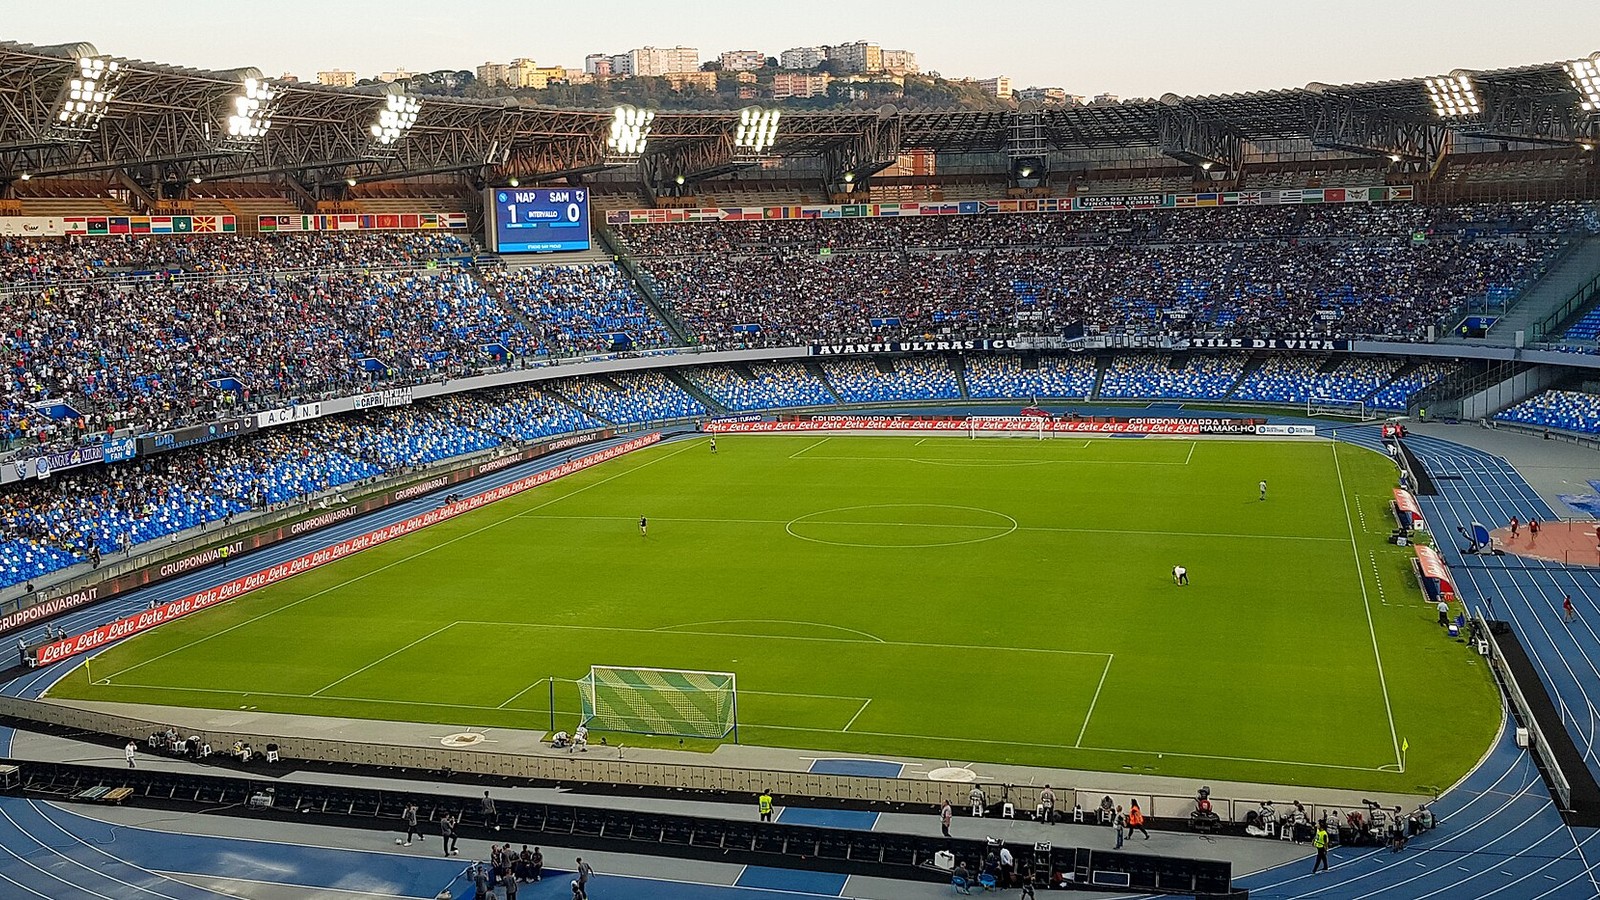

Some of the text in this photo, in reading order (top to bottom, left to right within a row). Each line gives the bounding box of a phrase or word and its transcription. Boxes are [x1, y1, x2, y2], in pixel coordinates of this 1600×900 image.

[516, 192, 569, 202] NAP SAM
[508, 204, 579, 223] 1 0
[820, 344, 891, 354] AVANTI
[900, 341, 974, 351] ULTRAS
[1252, 340, 1276, 348] DI
[1285, 340, 1334, 349] VITA
[361, 395, 381, 407] CAPRI
[727, 423, 749, 431] Lete
[773, 422, 796, 430] Lete
[796, 421, 818, 430] Lete
[820, 421, 841, 429] Lete
[842, 421, 864, 429] Lete
[865, 421, 886, 429] Lete
[887, 421, 909, 429] Lete
[909, 421, 932, 429] Lete
[933, 421, 955, 429] Lete
[956, 421, 979, 429] Lee
[980, 421, 1002, 429] Lete
[1003, 421, 1026, 430] Lete
[1051, 422, 1073, 430] Lete
[1124, 424, 1148, 432] Lete
[1149, 424, 1174, 432] Lete
[1174, 424, 1198, 433] Lete
[105, 446, 126, 454] NAPOLI
[110, 452, 122, 460] FAN
[48, 453, 69, 468] SANGUE
[395, 477, 448, 500] GRUPPONAVARRA.IT
[291, 506, 357, 533] GRUPPONAVARRA.IT
[40, 642, 72, 663] Lete
[74, 630, 103, 652] Lete
[106, 619, 134, 640] Lete
[136, 609, 162, 629] Lete
[164, 600, 190, 619] Lete
[192, 590, 216, 609] Lete
[217, 582, 241, 600] Lete
[242, 573, 264, 590] Lete
[266, 565, 287, 582] Lete
[289, 557, 309, 574] Lete
[310, 550, 330, 566] Lete
[331, 543, 350, 558] Lete
[351, 536, 368, 551] Lete
[370, 530, 387, 544] Lete
[388, 524, 405, 538] Lete
[406, 518, 422, 531] Lete
